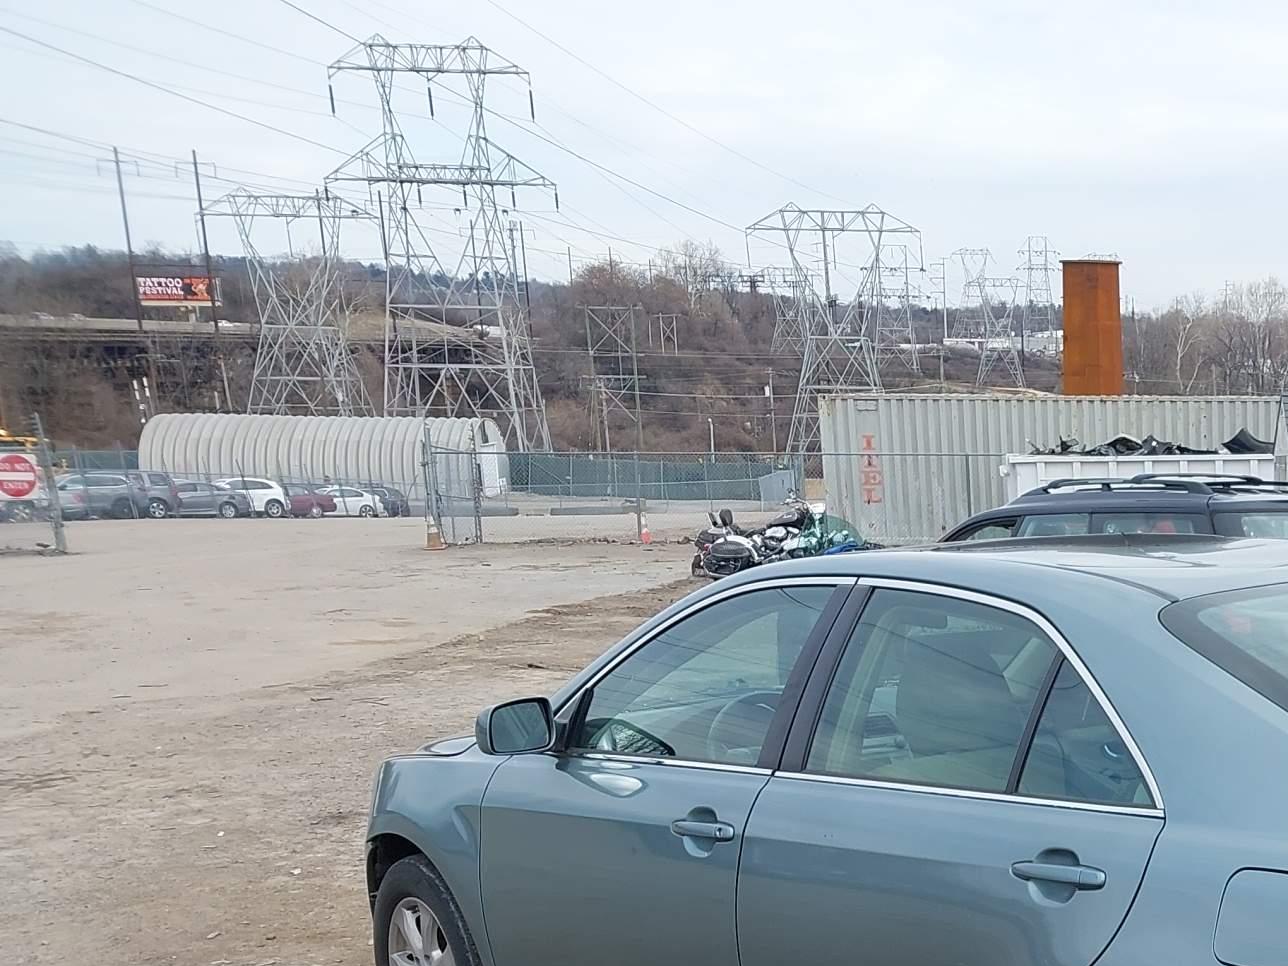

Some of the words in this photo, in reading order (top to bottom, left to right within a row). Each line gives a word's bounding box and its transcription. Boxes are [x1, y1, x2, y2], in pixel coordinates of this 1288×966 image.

[138, 277, 183, 287] TATTOO
[138, 286, 185, 295] FESTIVAL
[3, 480, 30, 489] ENTER
